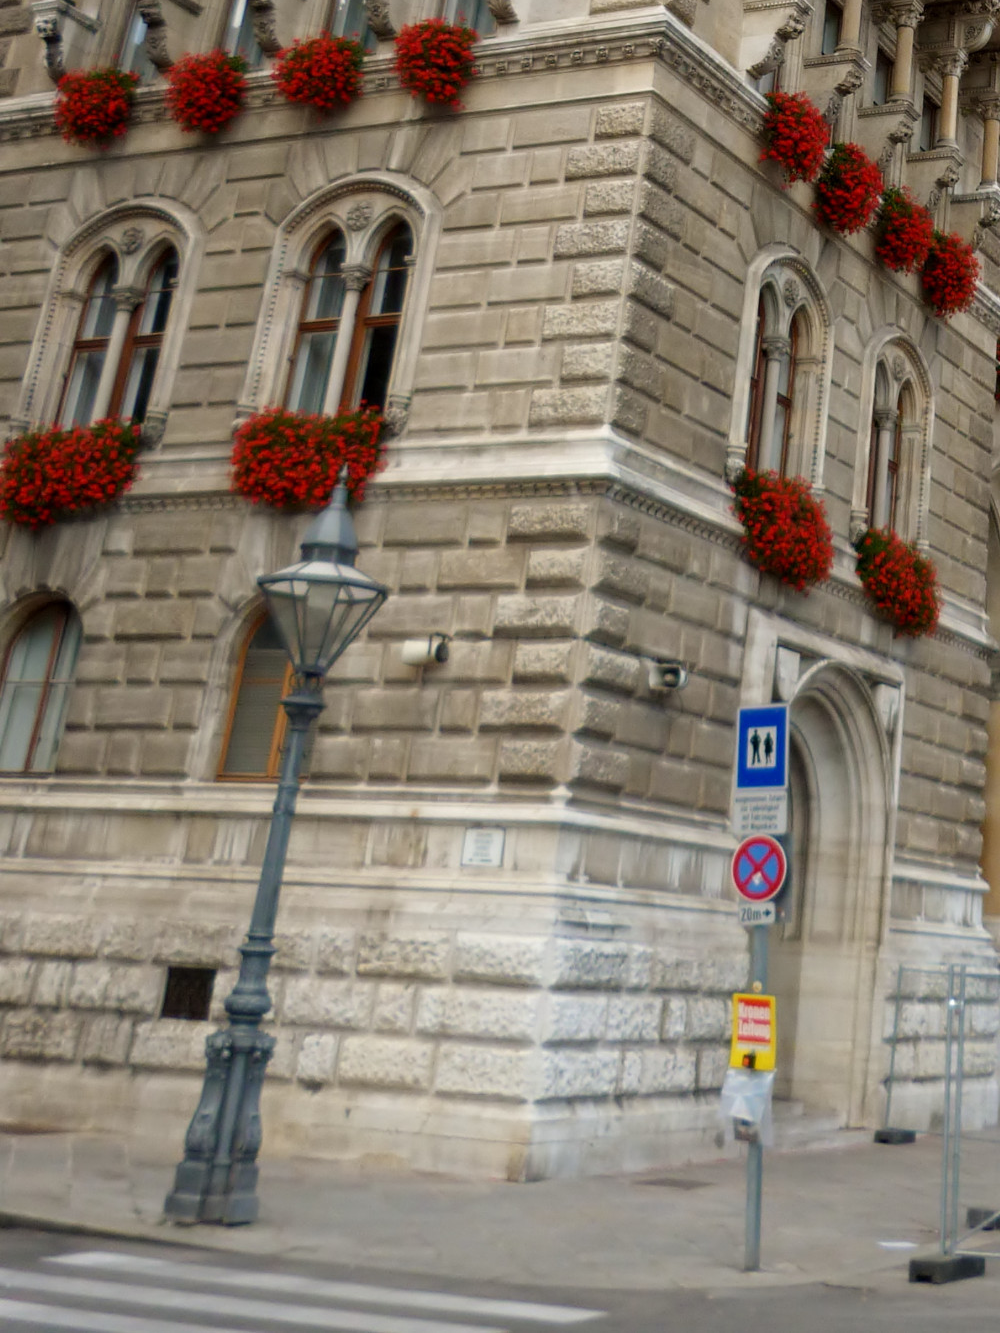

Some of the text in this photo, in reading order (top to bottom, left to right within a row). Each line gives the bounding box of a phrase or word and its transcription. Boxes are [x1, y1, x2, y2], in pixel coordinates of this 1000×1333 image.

[741, 907, 761, 922] 20m
[738, 1002, 770, 1020] Kronen
[738, 1019, 770, 1040] Zeitung
